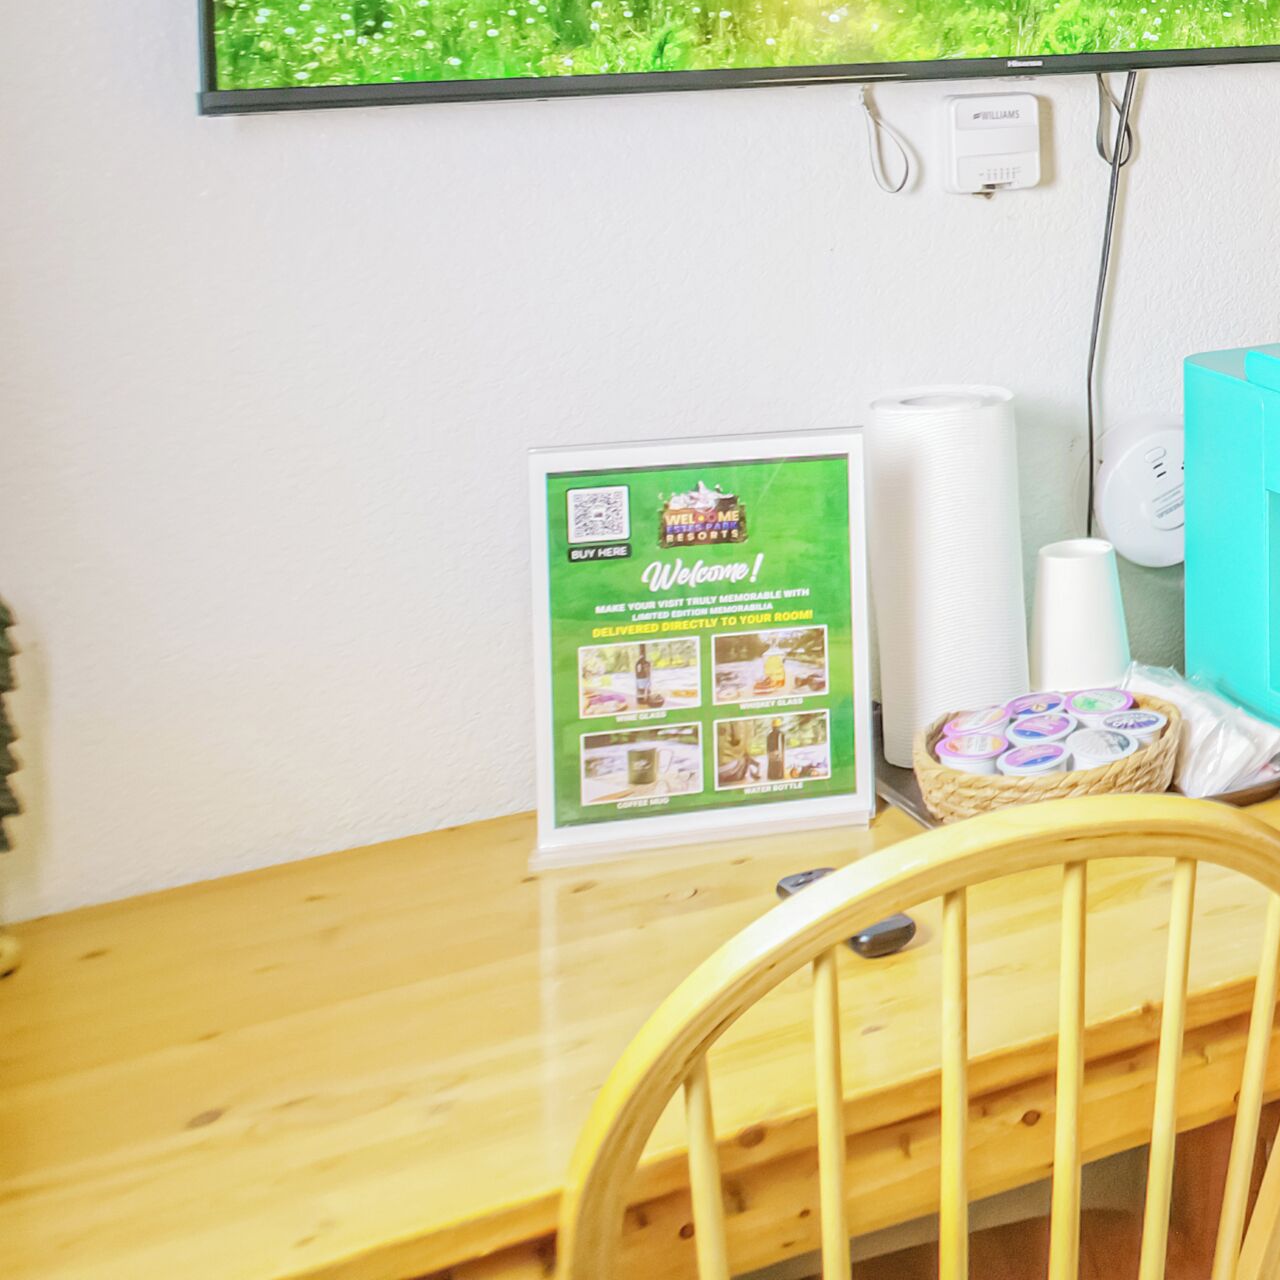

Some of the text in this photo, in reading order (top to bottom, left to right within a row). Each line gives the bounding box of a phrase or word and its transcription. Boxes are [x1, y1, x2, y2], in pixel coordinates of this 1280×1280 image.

[981, 110, 1020, 120] WILLIAMS
[666, 529, 738, 543] RESORTS
[571, 546, 628, 560] BUY HERE
[595, 587, 810, 614] MAKE YOUR VISIT TRULY MEMORABLE WITH
[631, 602, 774, 622] LIMITED EDITION MEMORABILIA
[592, 609, 813, 638] DELIVERED DIRECTLY TO YOUR ROOM!
